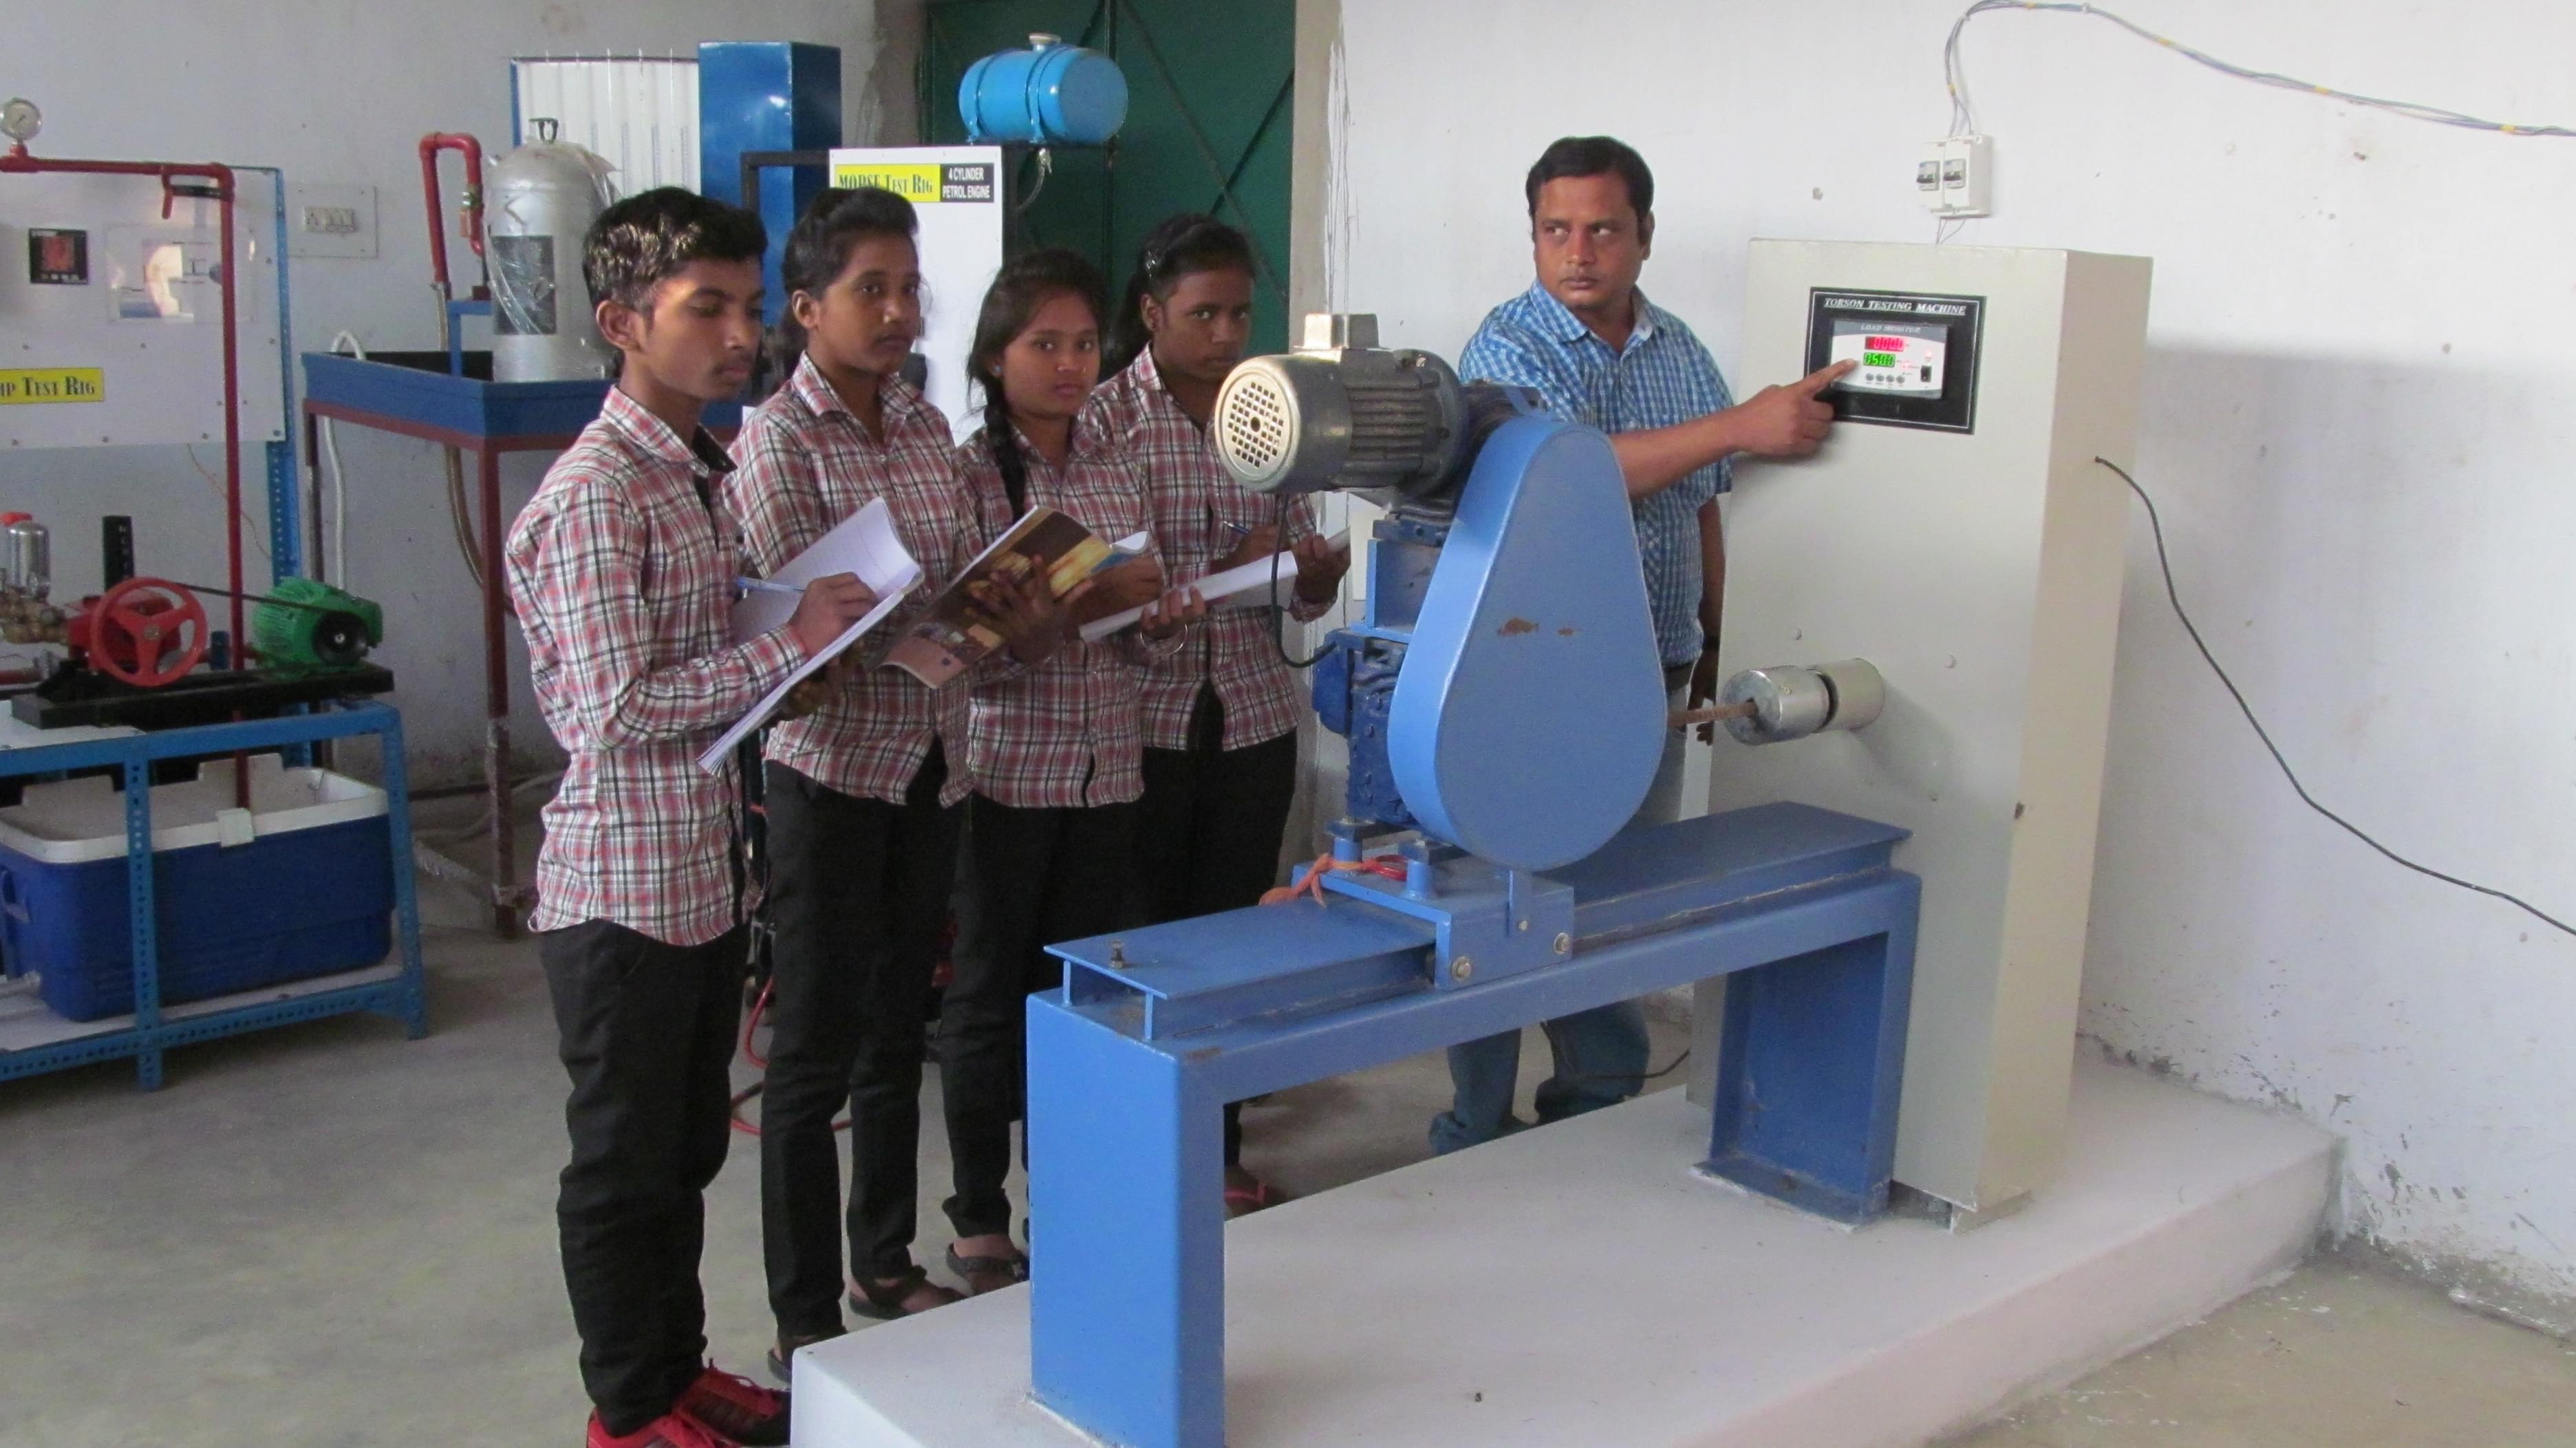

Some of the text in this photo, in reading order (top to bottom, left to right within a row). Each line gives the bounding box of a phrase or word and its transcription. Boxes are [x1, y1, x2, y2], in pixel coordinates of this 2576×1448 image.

[954, 167, 984, 181] CYLINDER
[912, 173, 933, 193] RIG
[942, 185, 991, 199] PETROL ENGINE
[1825, 297, 1967, 315] TORSON TESTING MACHINE
[1883, 325, 1921, 334] MONITOR
